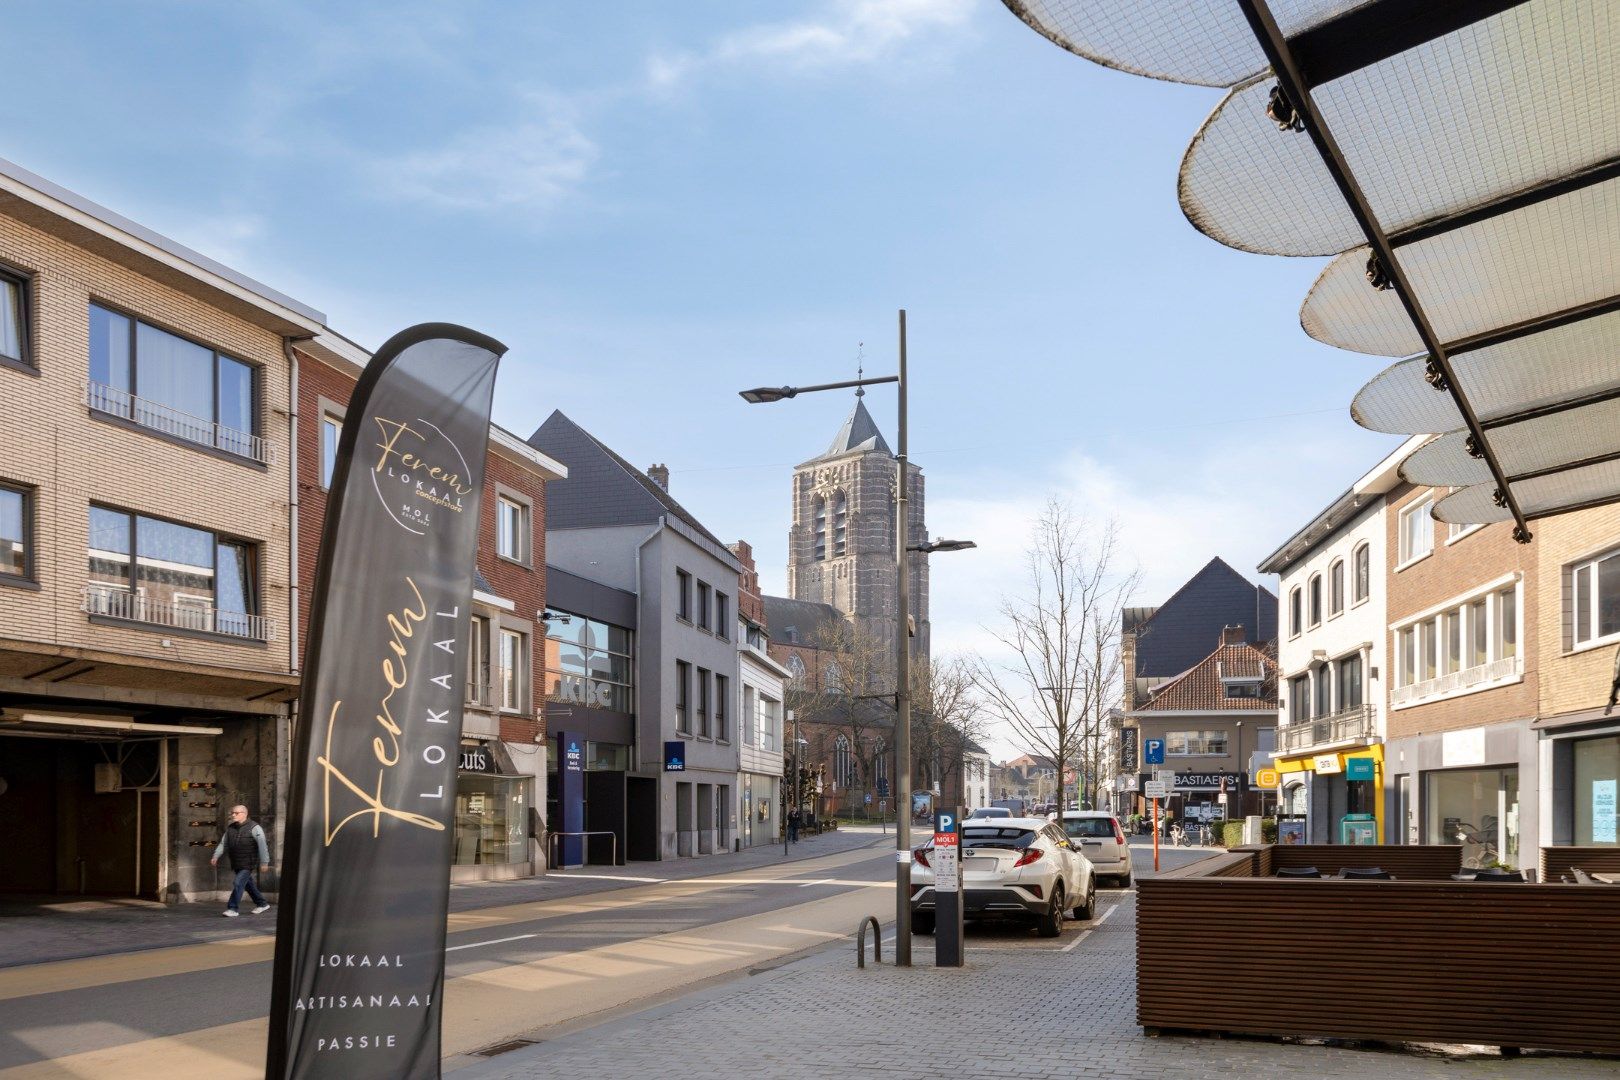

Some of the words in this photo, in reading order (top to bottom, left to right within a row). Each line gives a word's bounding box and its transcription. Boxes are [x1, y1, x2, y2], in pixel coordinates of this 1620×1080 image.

[388, 467, 463, 507] LOKAAL
[415, 489, 463, 513] conceptstore
[402, 504, 431, 522] MOL
[420, 606, 459, 798] LOKAAL
[567, 752, 580, 760] KBC
[1126, 730, 1134, 767] BASTIAENS
[1149, 741, 1160, 755] P
[940, 815, 953, 832] P
[320, 954, 404, 967] LOKAAL
[295, 994, 432, 1010] ARTISANAAL
[318, 1035, 396, 1051] PASSIE
